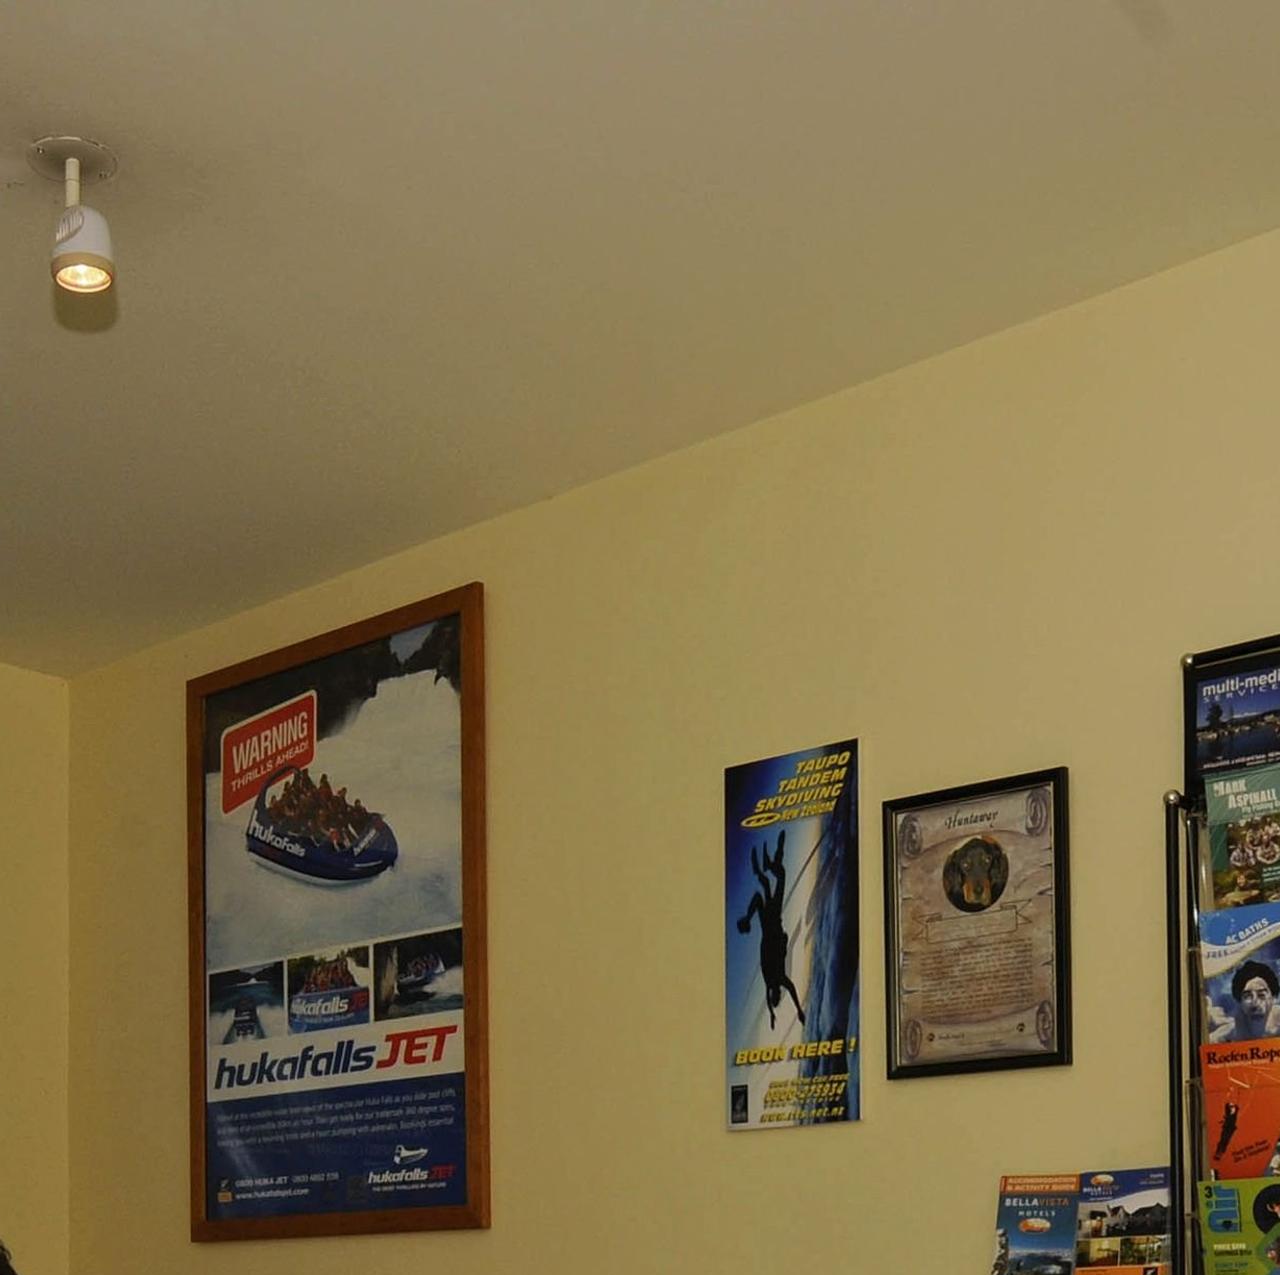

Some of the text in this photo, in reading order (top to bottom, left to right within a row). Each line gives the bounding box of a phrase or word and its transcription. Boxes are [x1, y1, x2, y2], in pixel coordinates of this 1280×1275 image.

[232, 710, 309, 774] WARNING
[231, 740, 310, 793] THRILLS AHEAD!
[796, 752, 851, 774] TAUPO
[777, 768, 848, 793] TANDEM
[754, 783, 842, 814] SKYDIVING
[943, 809, 999, 829] Huntaway
[376, 1025, 458, 1070] JET
[736, 1047, 785, 1066] BOOK
[792, 1041, 844, 1062] HERE
